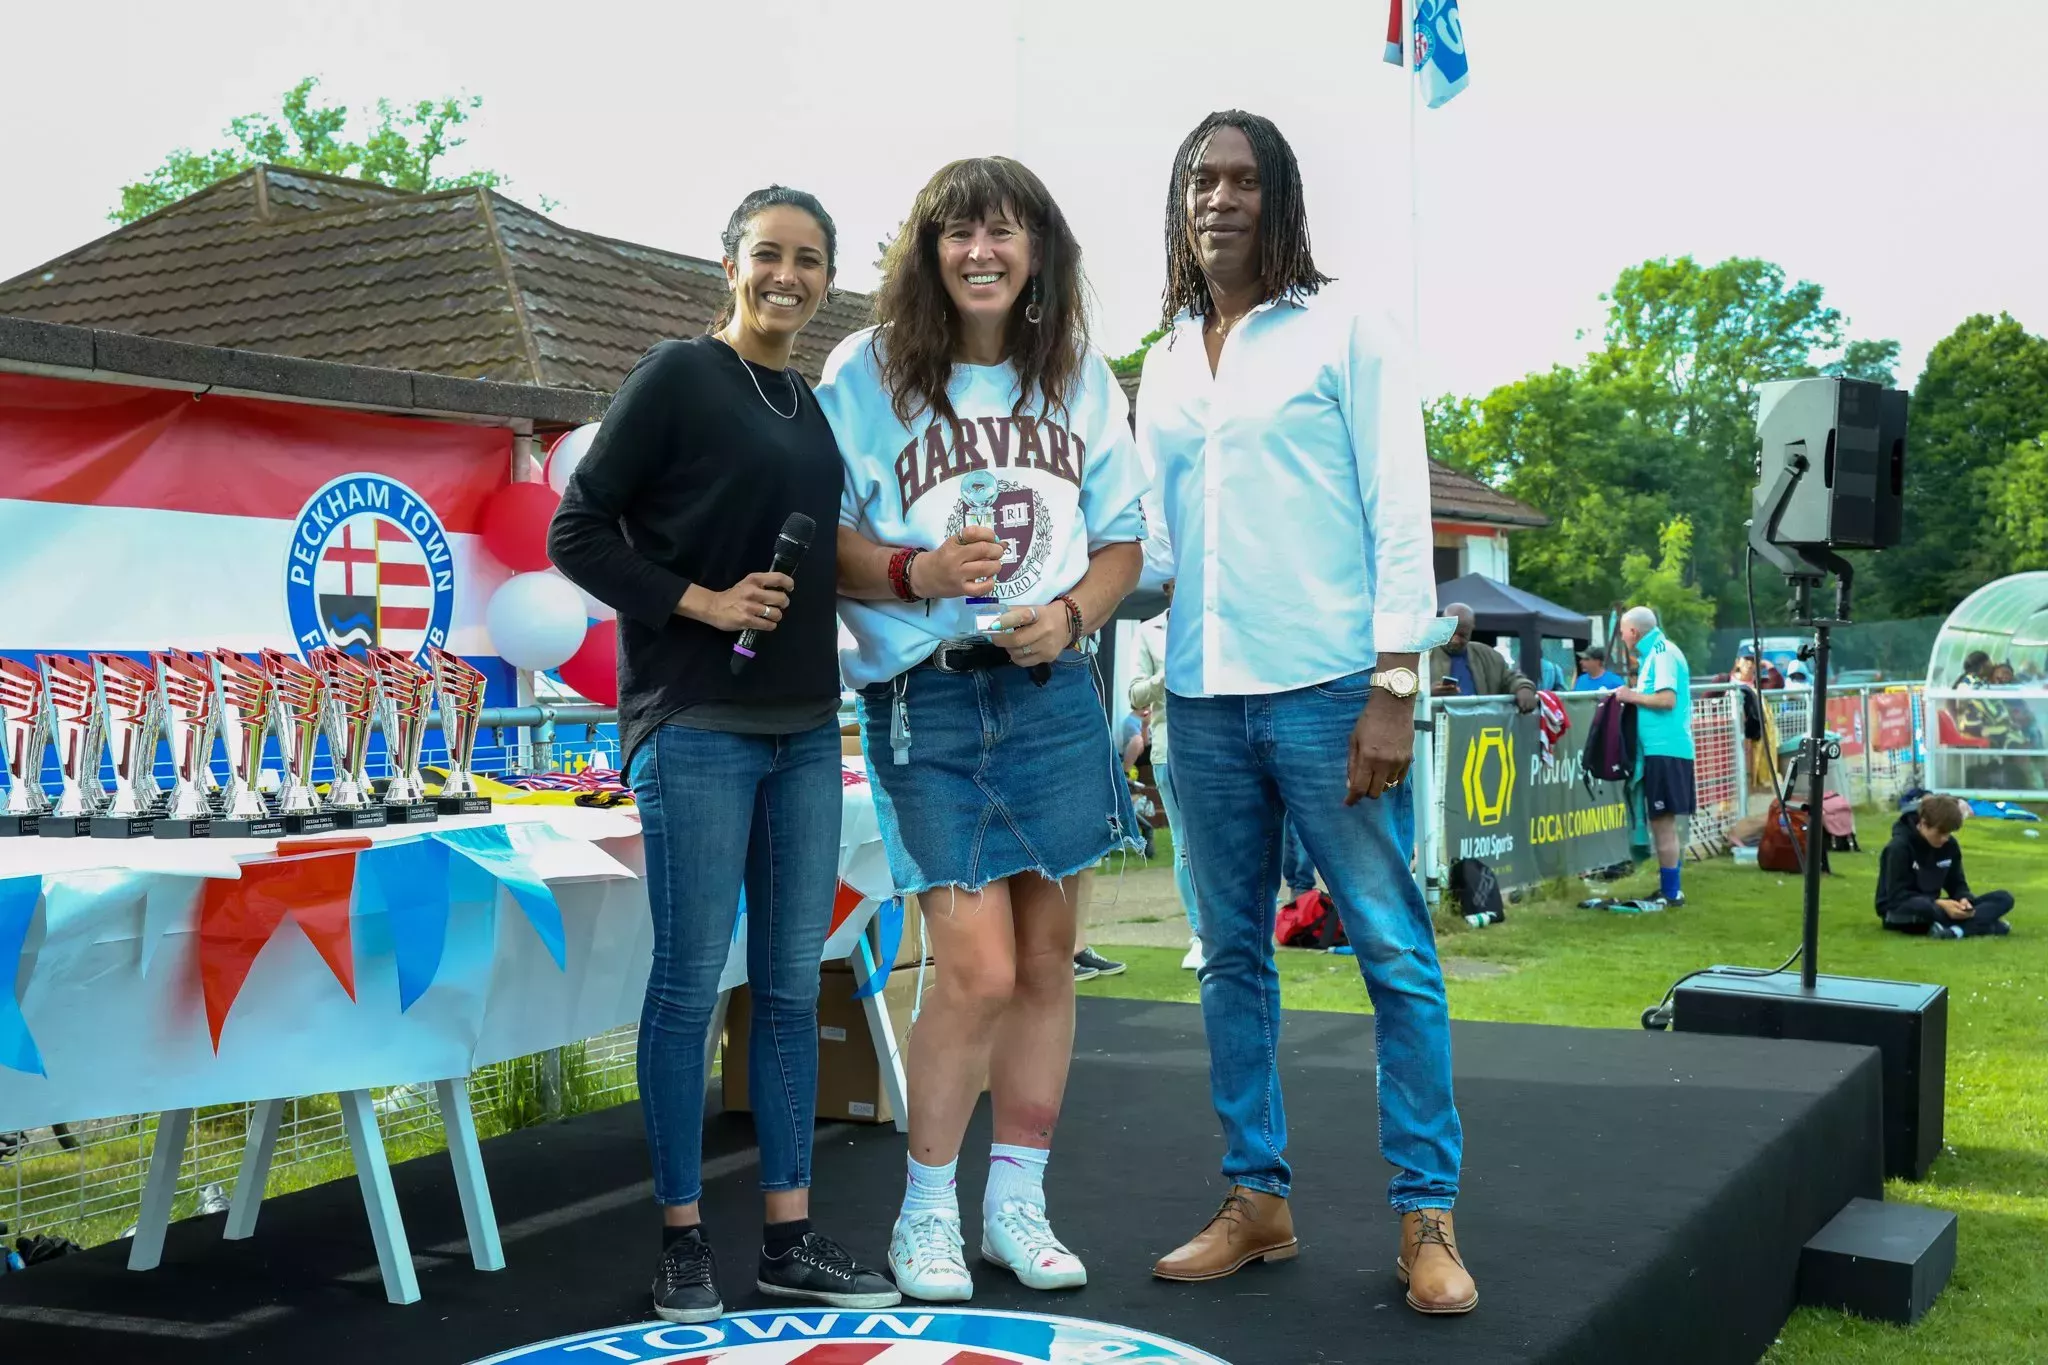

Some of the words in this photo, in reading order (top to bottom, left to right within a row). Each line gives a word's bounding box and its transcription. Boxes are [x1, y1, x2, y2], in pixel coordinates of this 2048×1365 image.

[894, 416, 1086, 523] HARVARD
[290, 481, 390, 587] PECKHAM
[399, 494, 453, 592] TOWN
[990, 576, 1032, 597] RVARD
[562, 1313, 936, 1361] TOWN
